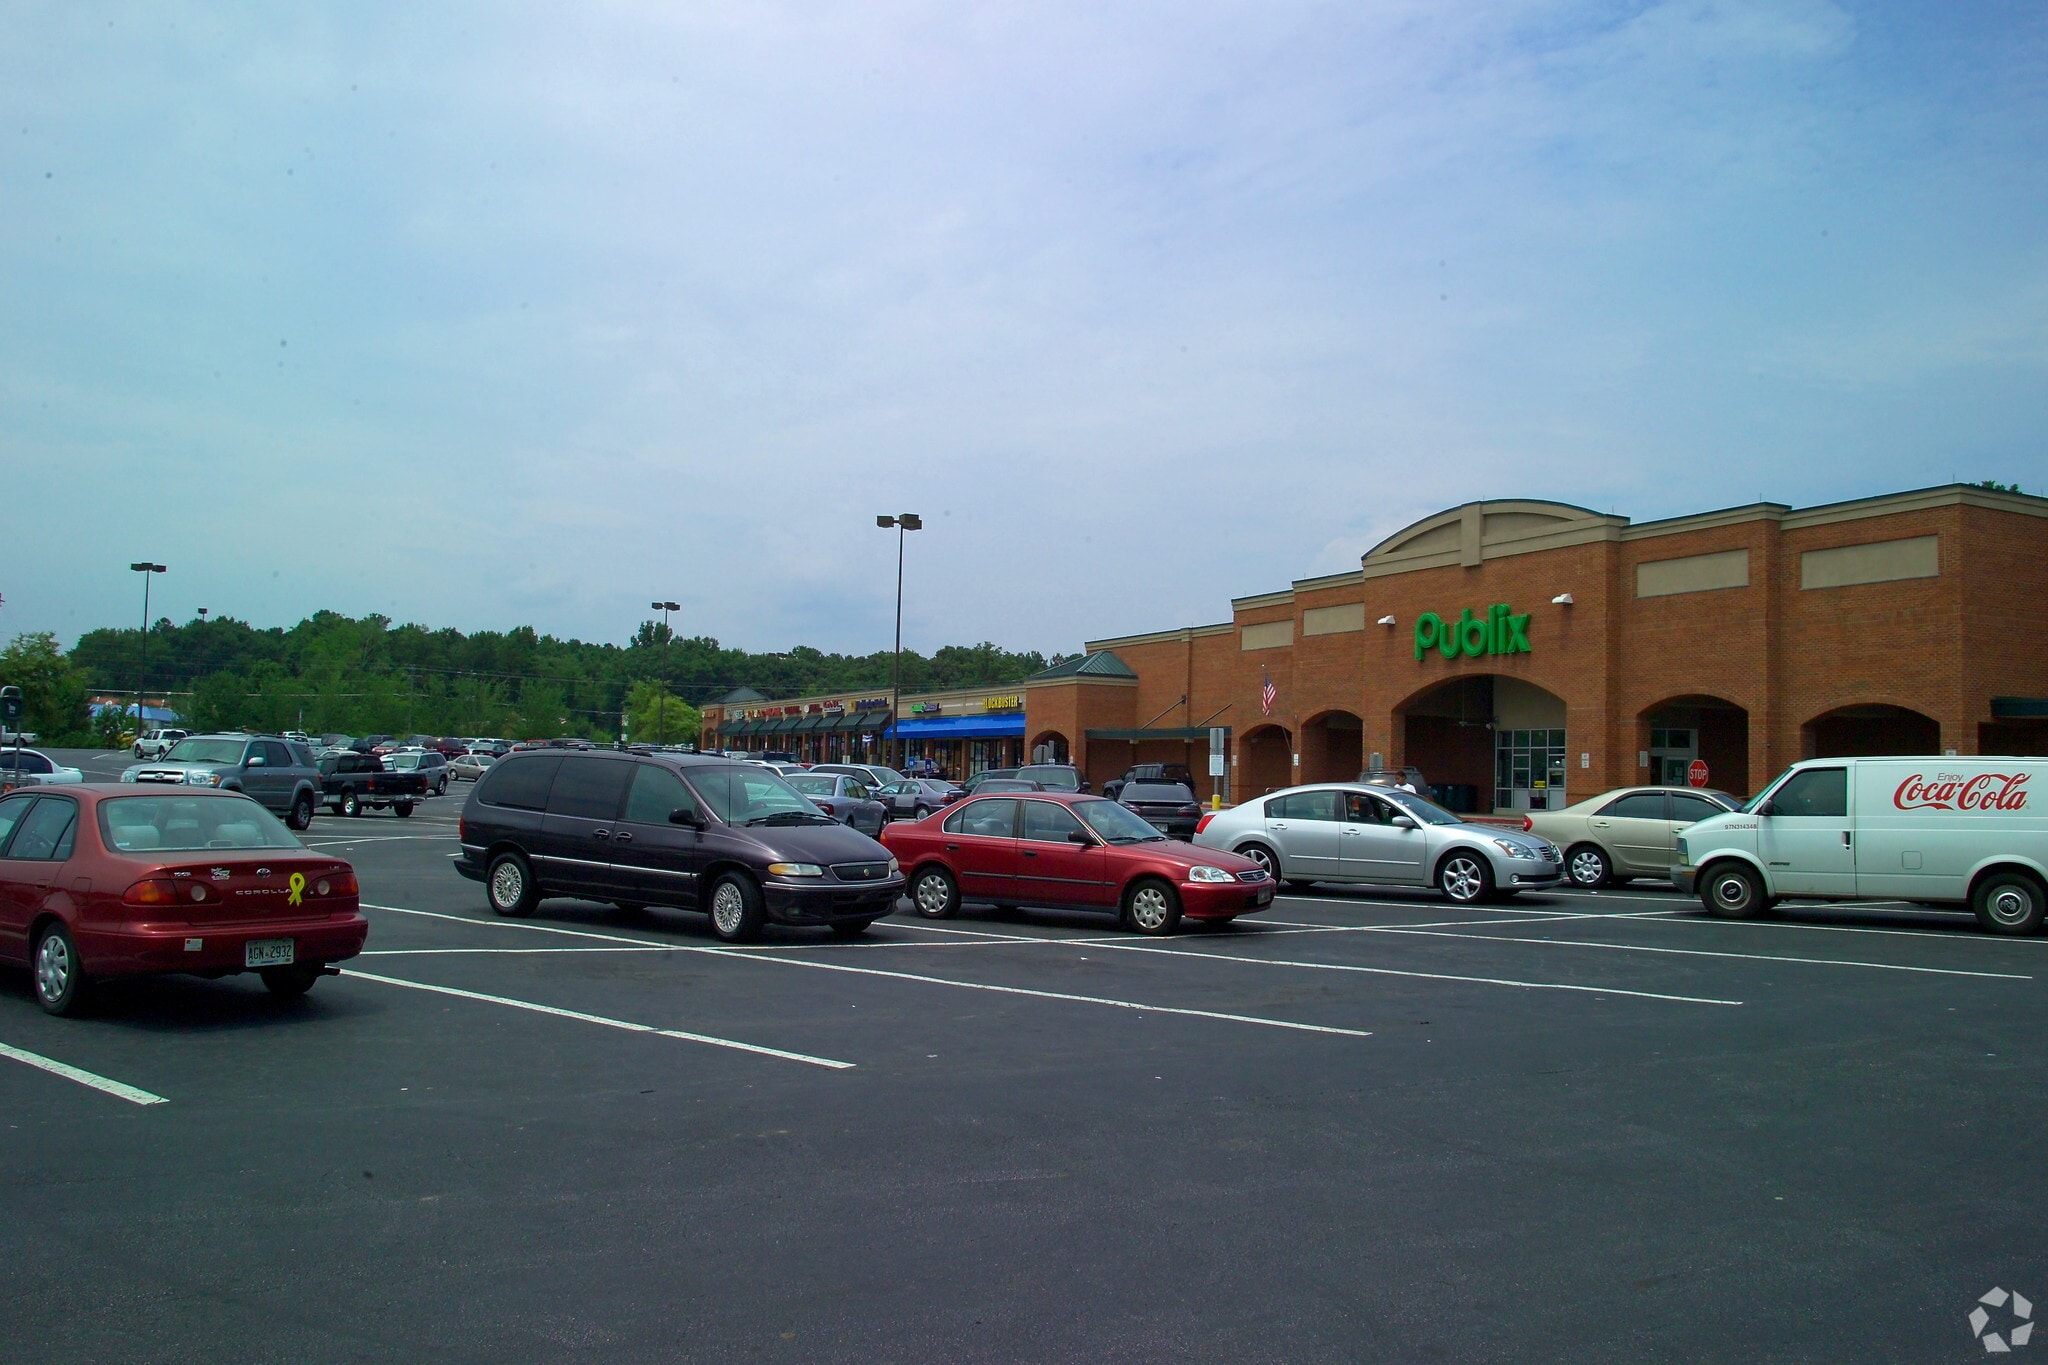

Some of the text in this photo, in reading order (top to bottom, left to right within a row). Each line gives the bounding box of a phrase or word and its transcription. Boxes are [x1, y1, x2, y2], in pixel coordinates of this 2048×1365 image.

[1415, 603, 1531, 661] Publix
[982, 696, 1018, 709] BLOCKBUSTER
[1689, 769, 1707, 780] STOP
[1938, 772, 1963, 782] Enjoy
[1893, 772, 2032, 811] Coca-Cola
[270, 944, 292, 959] 2932
